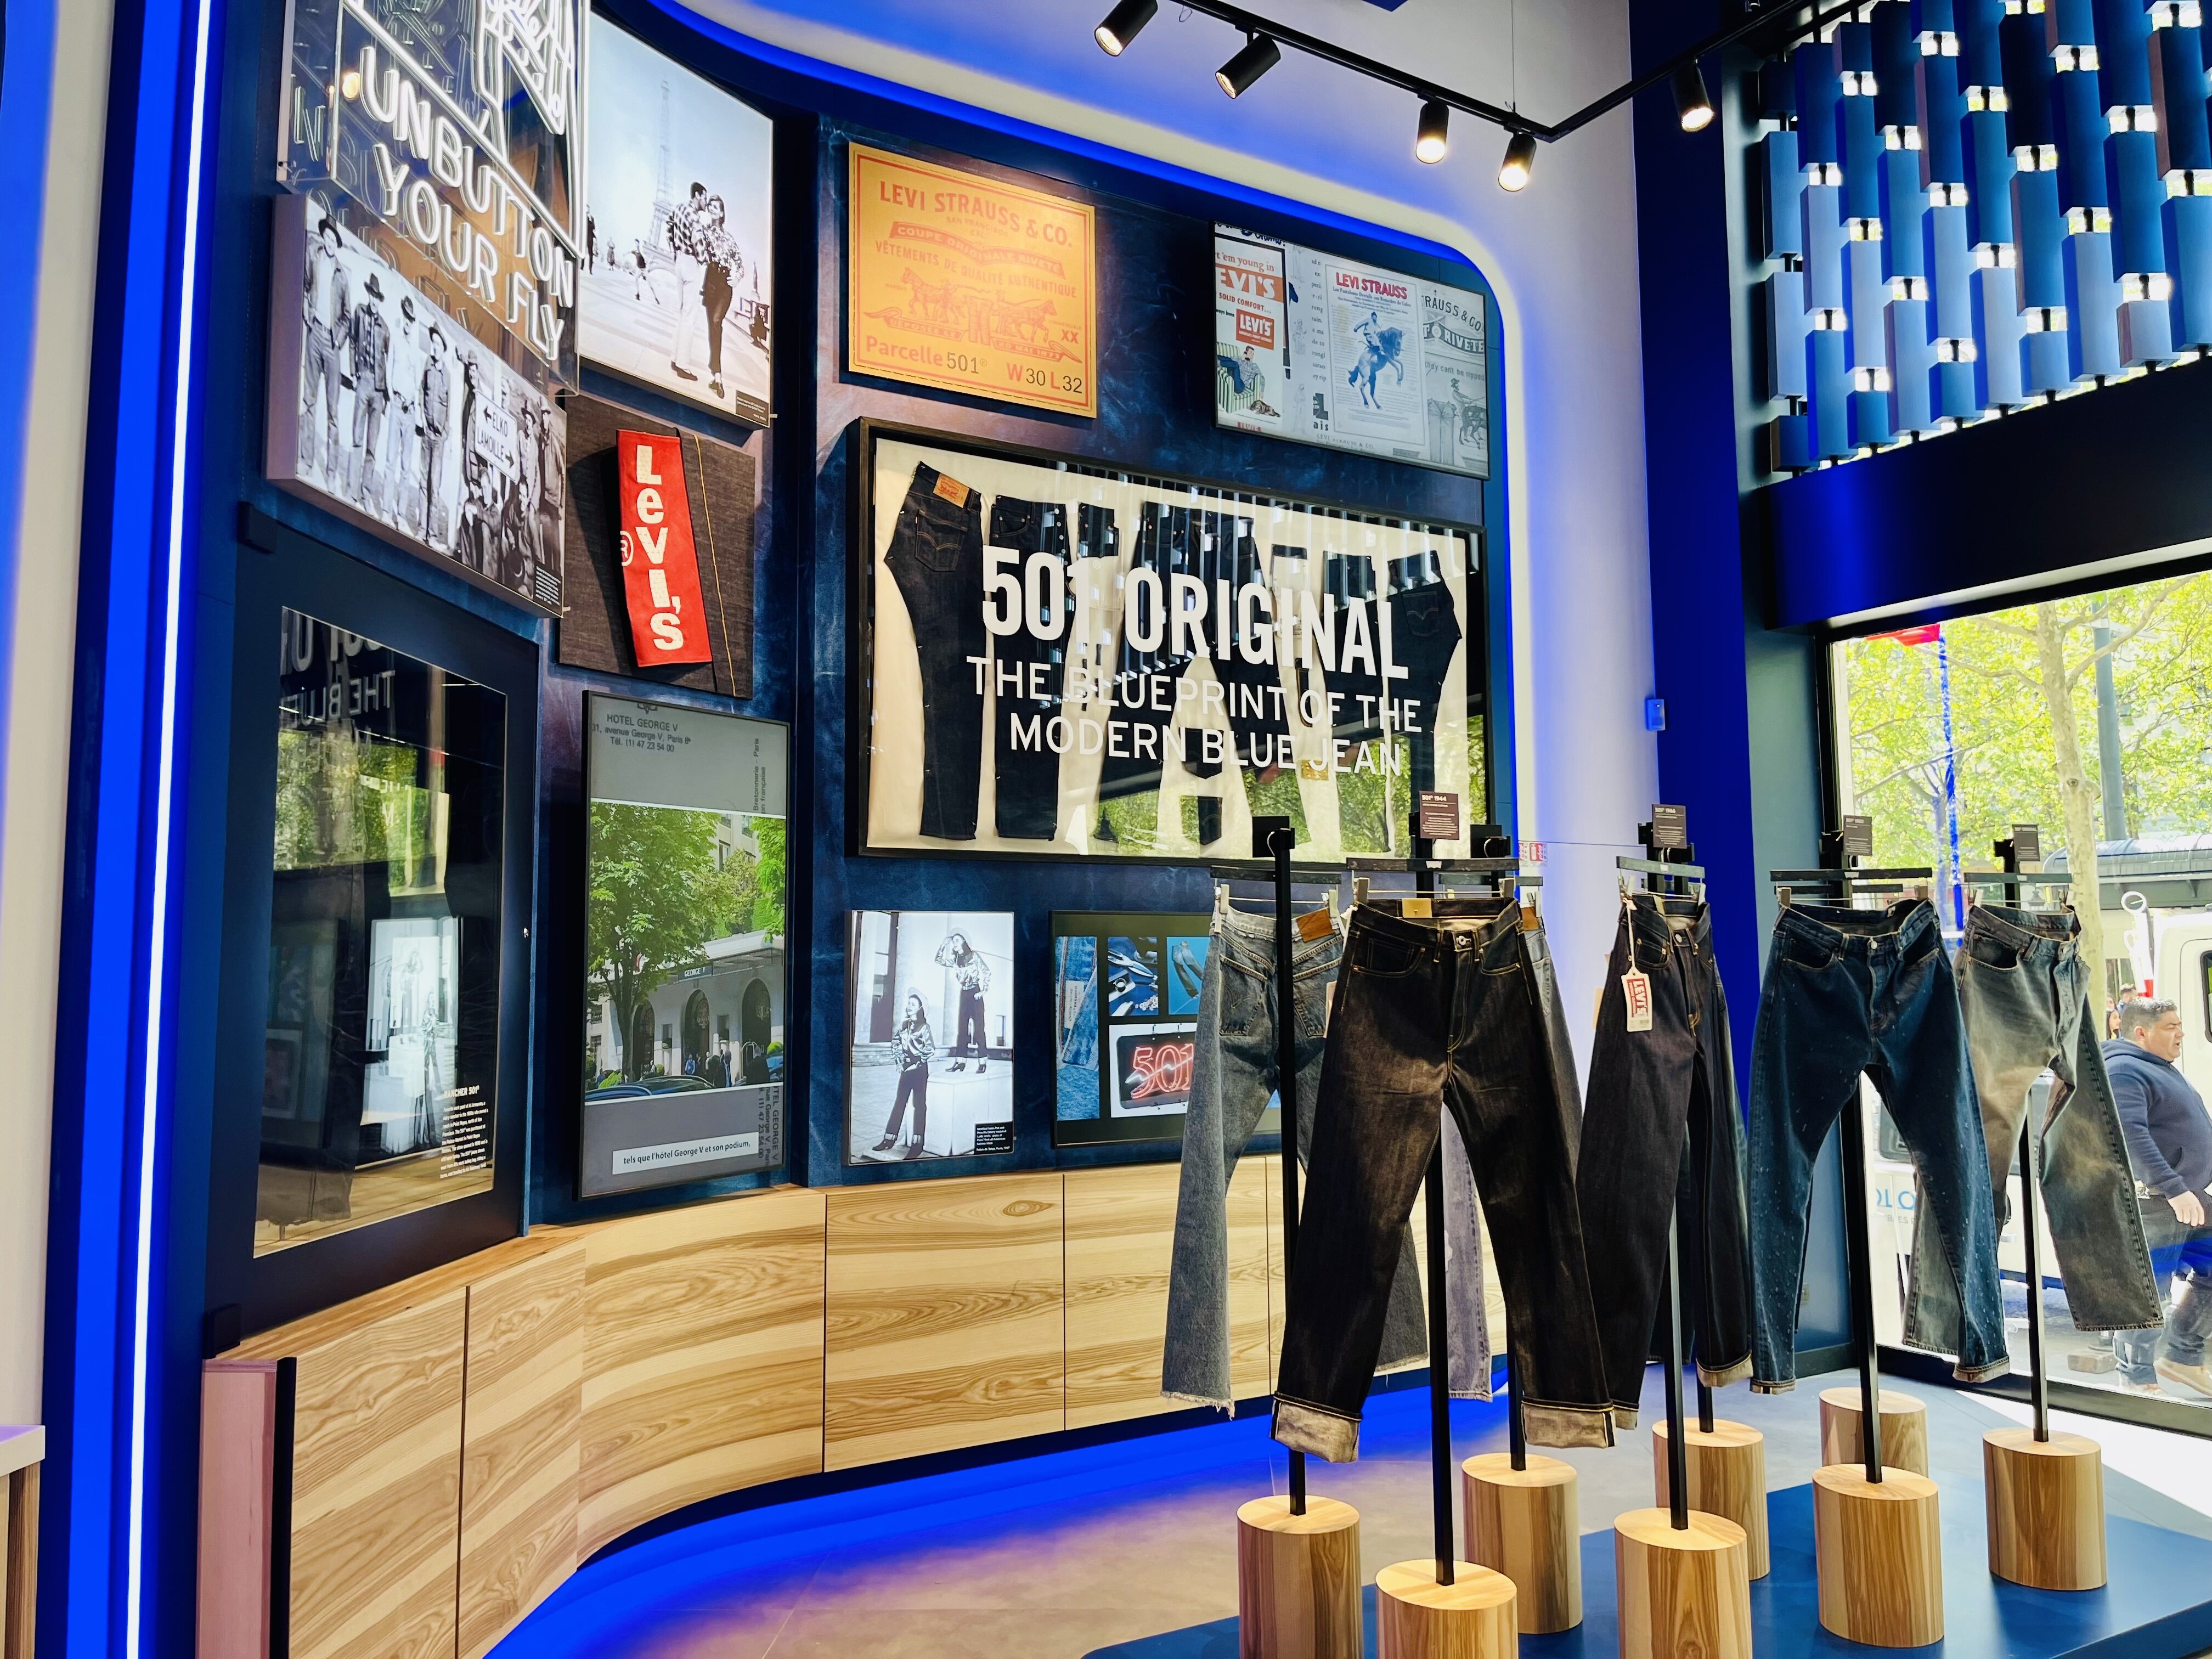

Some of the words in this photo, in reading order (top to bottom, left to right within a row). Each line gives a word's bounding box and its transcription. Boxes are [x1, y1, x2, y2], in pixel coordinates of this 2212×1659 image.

[359, 46, 573, 308] UNBUTTON
[373, 143, 498, 302] YOUR
[880, 180, 925, 211] LEVI
[934, 193, 1020, 233] STRAUSS
[1025, 219, 1039, 238] &
[1043, 223, 1073, 247] CO.
[897, 227, 943, 241] COUPE
[874, 240, 939, 266] VÊTEMENTS
[944, 258, 957, 273] DE
[1008, 274, 1077, 298] AUTHENTIQUE
[1237, 257, 1264, 273] young
[1266, 261, 1274, 272] in
[1219, 292, 1235, 302] SOLID
[1336, 272, 1359, 290] LEVI
[1361, 278, 1408, 300] STRAUSS
[506, 272, 564, 360] FLY
[1461, 309, 1467, 322] &
[866, 335, 943, 366] Parcelle
[1061, 330, 1079, 344] XX
[492, 411, 509, 437] ELKO
[1124, 566, 1409, 680] ORIGINAL
[966, 655, 1052, 701] THE
[1068, 664, 1288, 721] BLUEPRINT
[1300, 688, 1347, 726] OF
[1356, 694, 1422, 733] THE
[605, 726, 629, 736] avenue
[631, 729, 656, 741] George
[667, 734, 683, 743] Paris
[607, 714, 635, 726] HOTEL
[637, 718, 670, 731] GEORGE
[647, 742, 655, 750] 23
[666, 744, 675, 753] 00
[1011, 712, 1187, 762] MODERN
[1206, 730, 1297, 771] BLUE
[1308, 737, 1401, 777] JEAN
[1130, 1043, 1194, 1099] 501
[758, 1111, 764, 1121] 47
[623, 1155, 636, 1164] tels
[637, 1155, 651, 1164] que
[652, 1150, 673, 1160] l'hôtel
[674, 1148, 698, 1156] George
[725, 1141, 751, 1150] podium,
